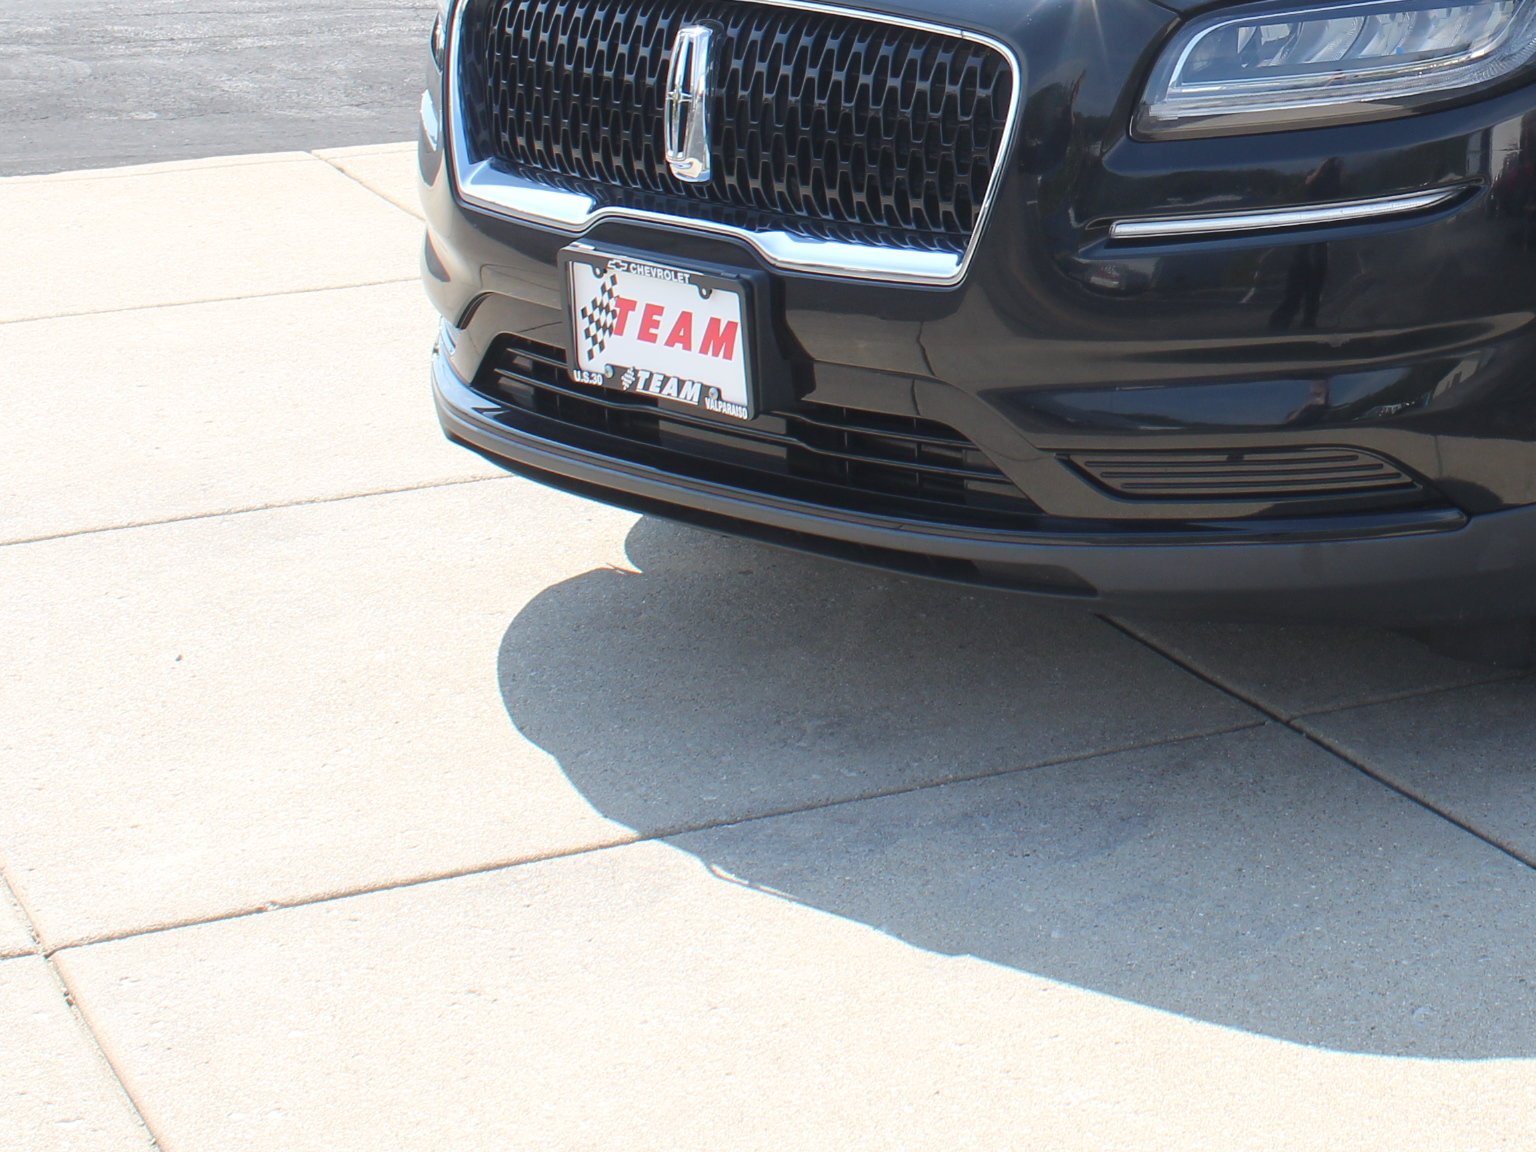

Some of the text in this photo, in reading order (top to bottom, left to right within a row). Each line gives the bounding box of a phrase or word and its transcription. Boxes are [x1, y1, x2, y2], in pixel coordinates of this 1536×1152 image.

[629, 263, 691, 285] CHEVROLET
[612, 297, 739, 361] TEAM
[636, 370, 702, 403] TEAM
[705, 397, 748, 420] VALPARAISO
